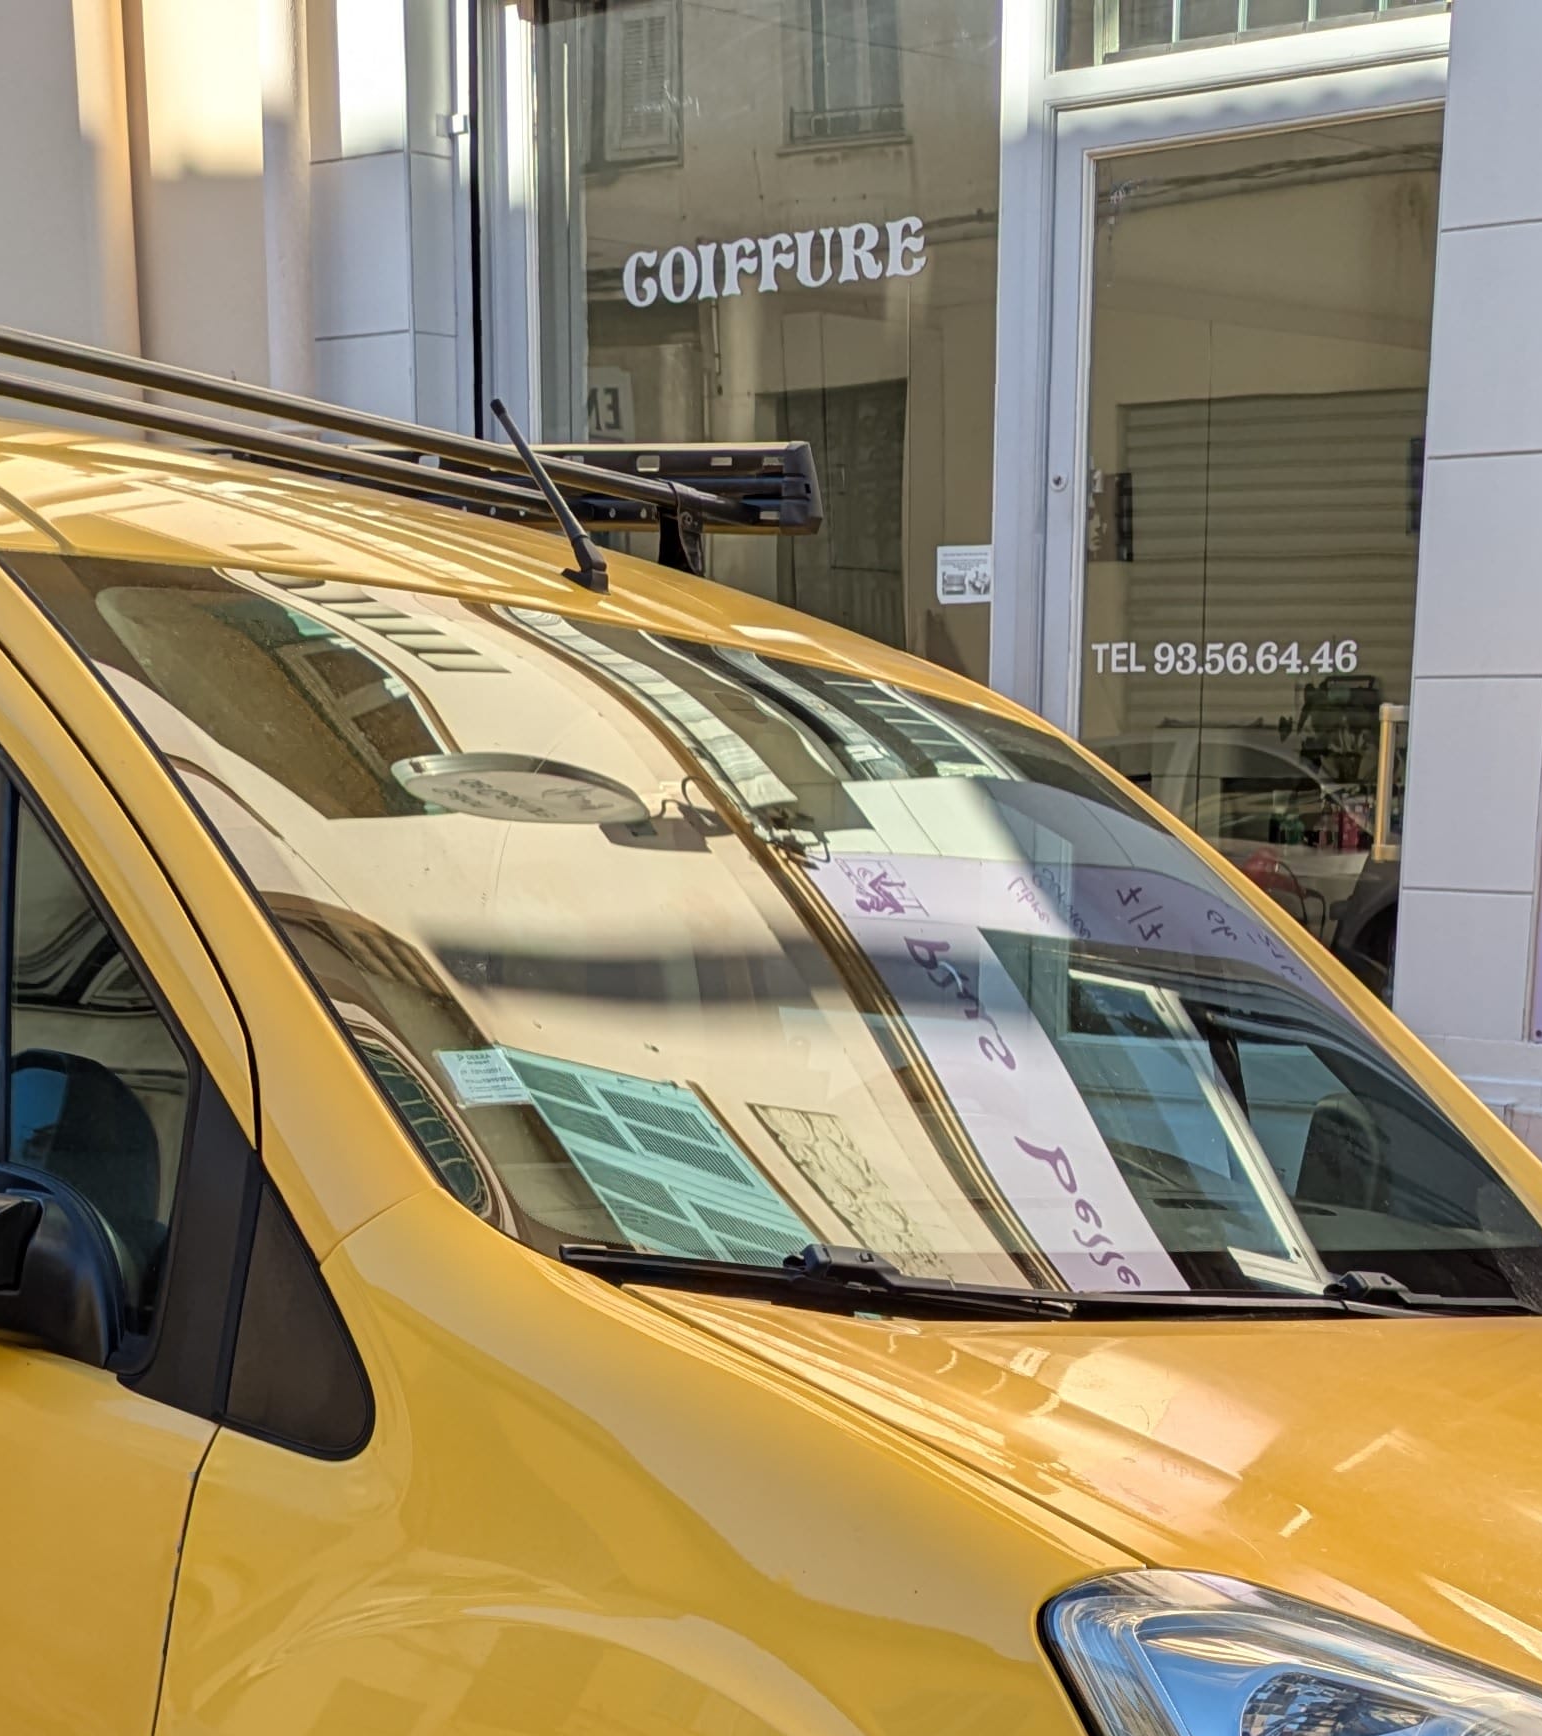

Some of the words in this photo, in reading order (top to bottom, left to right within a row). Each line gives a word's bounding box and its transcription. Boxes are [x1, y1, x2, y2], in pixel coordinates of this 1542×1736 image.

[622, 215, 927, 308] COIFFURE
[1091, 641, 1146, 674] TEL
[1153, 639, 1358, 675] 93.56.64.46
